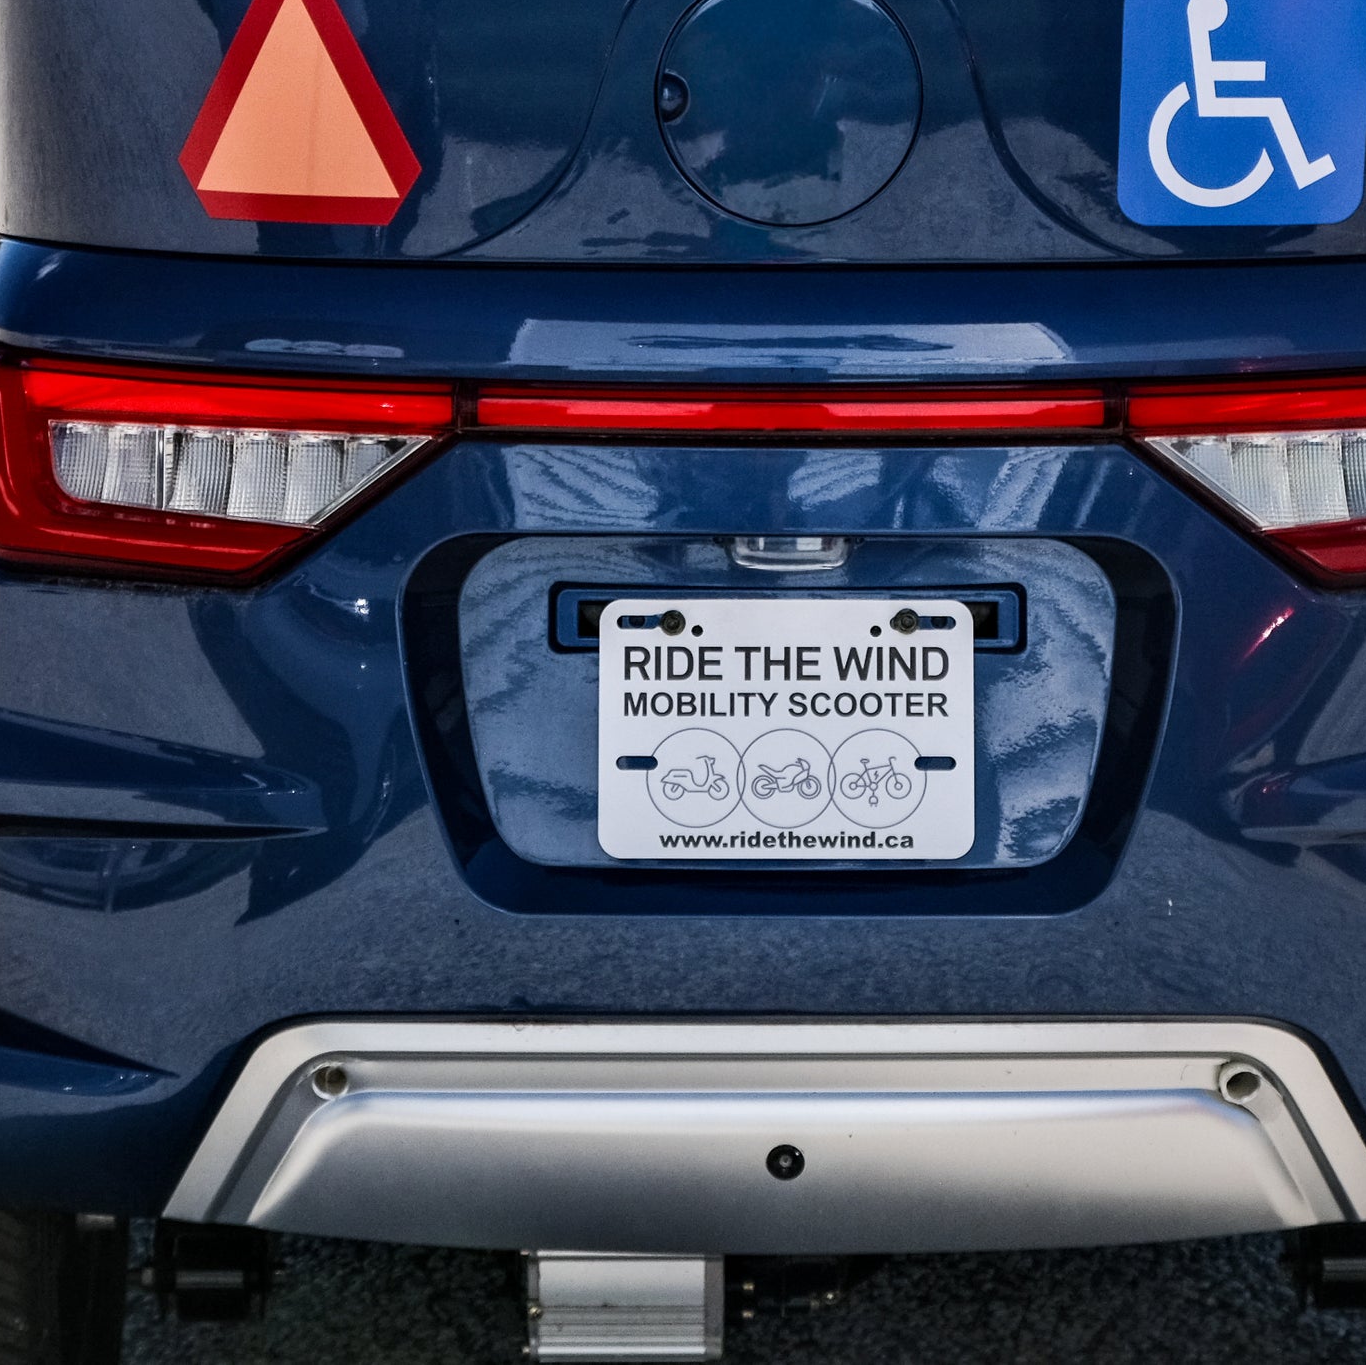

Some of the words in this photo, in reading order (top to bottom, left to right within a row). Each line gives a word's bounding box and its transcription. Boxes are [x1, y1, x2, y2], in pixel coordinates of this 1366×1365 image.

[624, 646, 724, 681] RIDE
[734, 646, 821, 681] THE
[833, 646, 949, 681] WIND
[624, 691, 779, 717] MOBILITY
[788, 691, 949, 717] SCOOTER
[659, 831, 914, 849] www.ridethewind.ca
